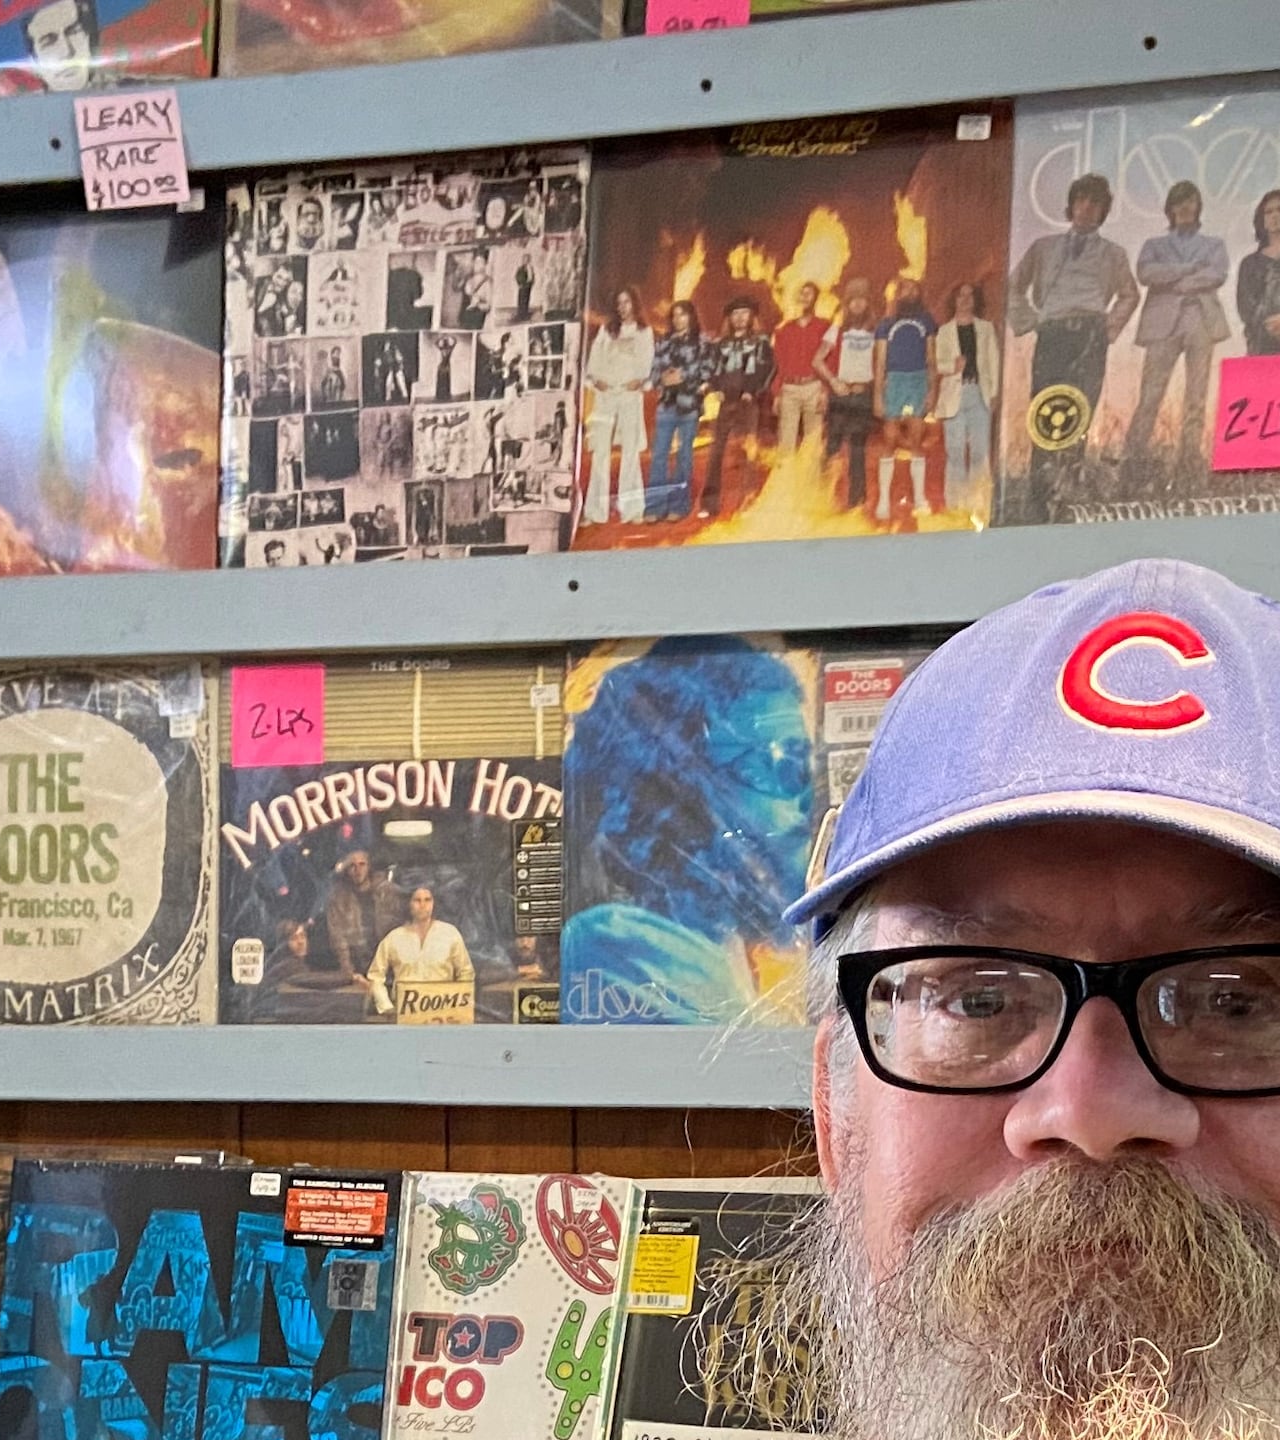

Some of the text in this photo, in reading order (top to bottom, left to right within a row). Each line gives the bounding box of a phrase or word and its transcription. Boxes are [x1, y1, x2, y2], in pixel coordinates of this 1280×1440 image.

[82, 98, 173, 135] LEARY
[94, 143, 162, 172] RARE
[834, 677, 892, 695] DOORS
[1056, 612, 1217, 737] C
[220, 758, 456, 871] MORRISON
[107, 890, 135, 920] Ca
[3, 941, 161, 1023] MATRIX
[400, 988, 472, 1017] ROOMS
[407, 1310, 526, 1366] TOP
